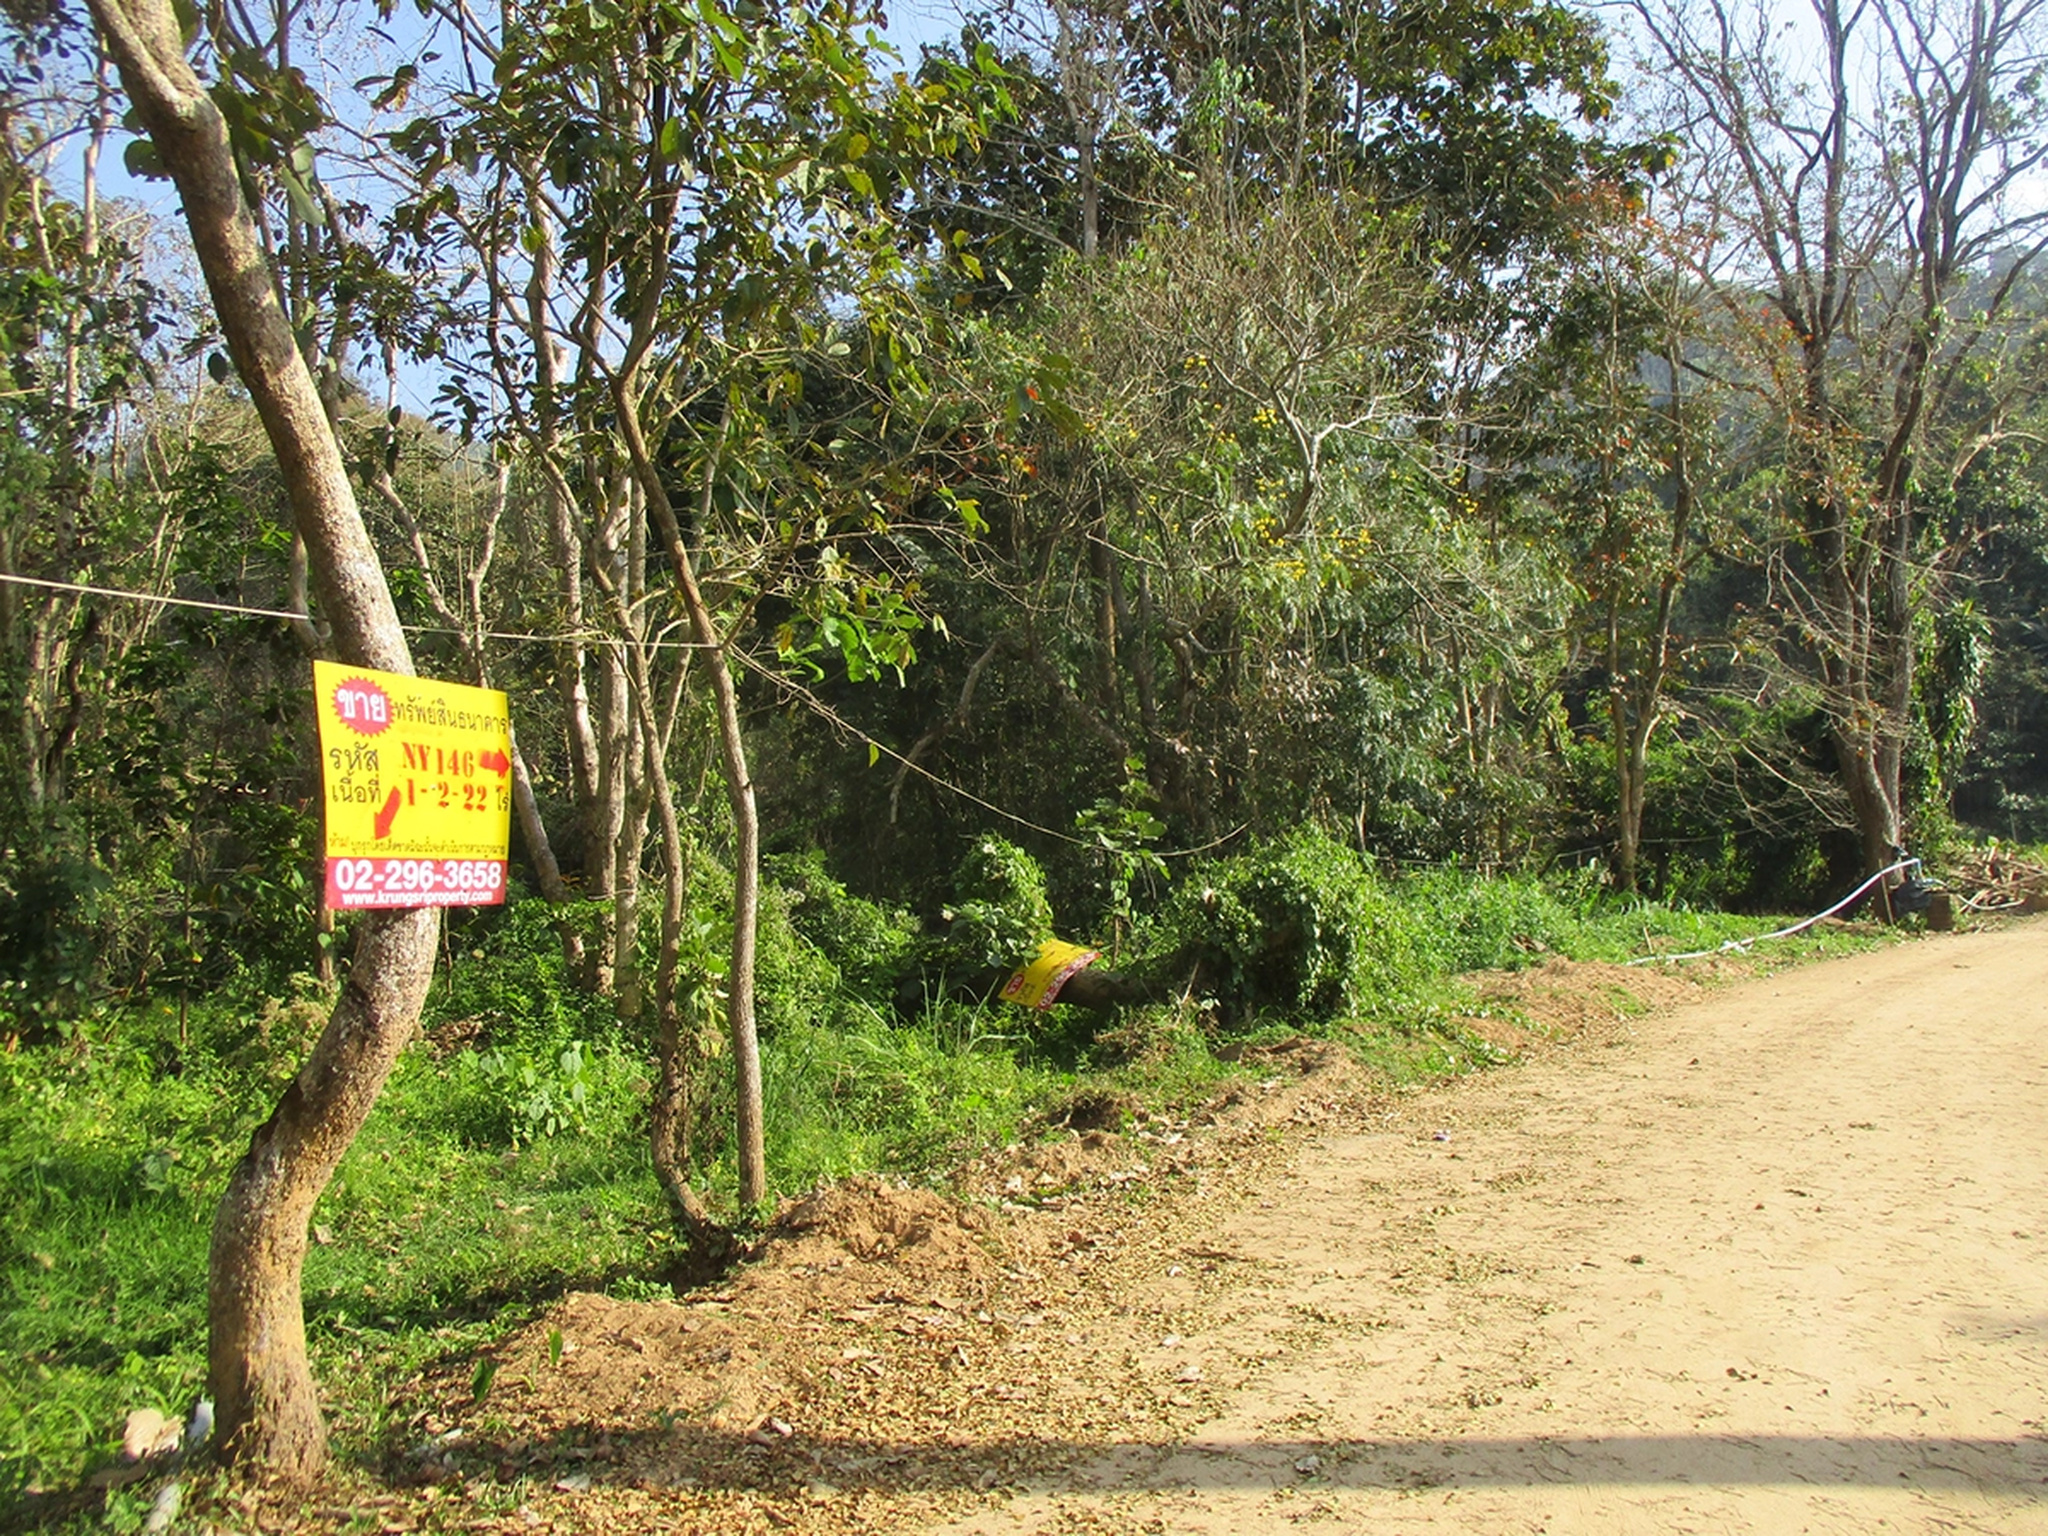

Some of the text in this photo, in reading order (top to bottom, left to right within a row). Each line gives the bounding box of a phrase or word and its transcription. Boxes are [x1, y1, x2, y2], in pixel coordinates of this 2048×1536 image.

[337, 688, 508, 735] ขาย ทรัพย์สินธนาคาร
[329, 741, 475, 779] รหัส NY146
[332, 769, 381, 804] เนื้อที่
[407, 778, 488, 813] 1-2-22
[335, 858, 502, 891] 02-296-3658
